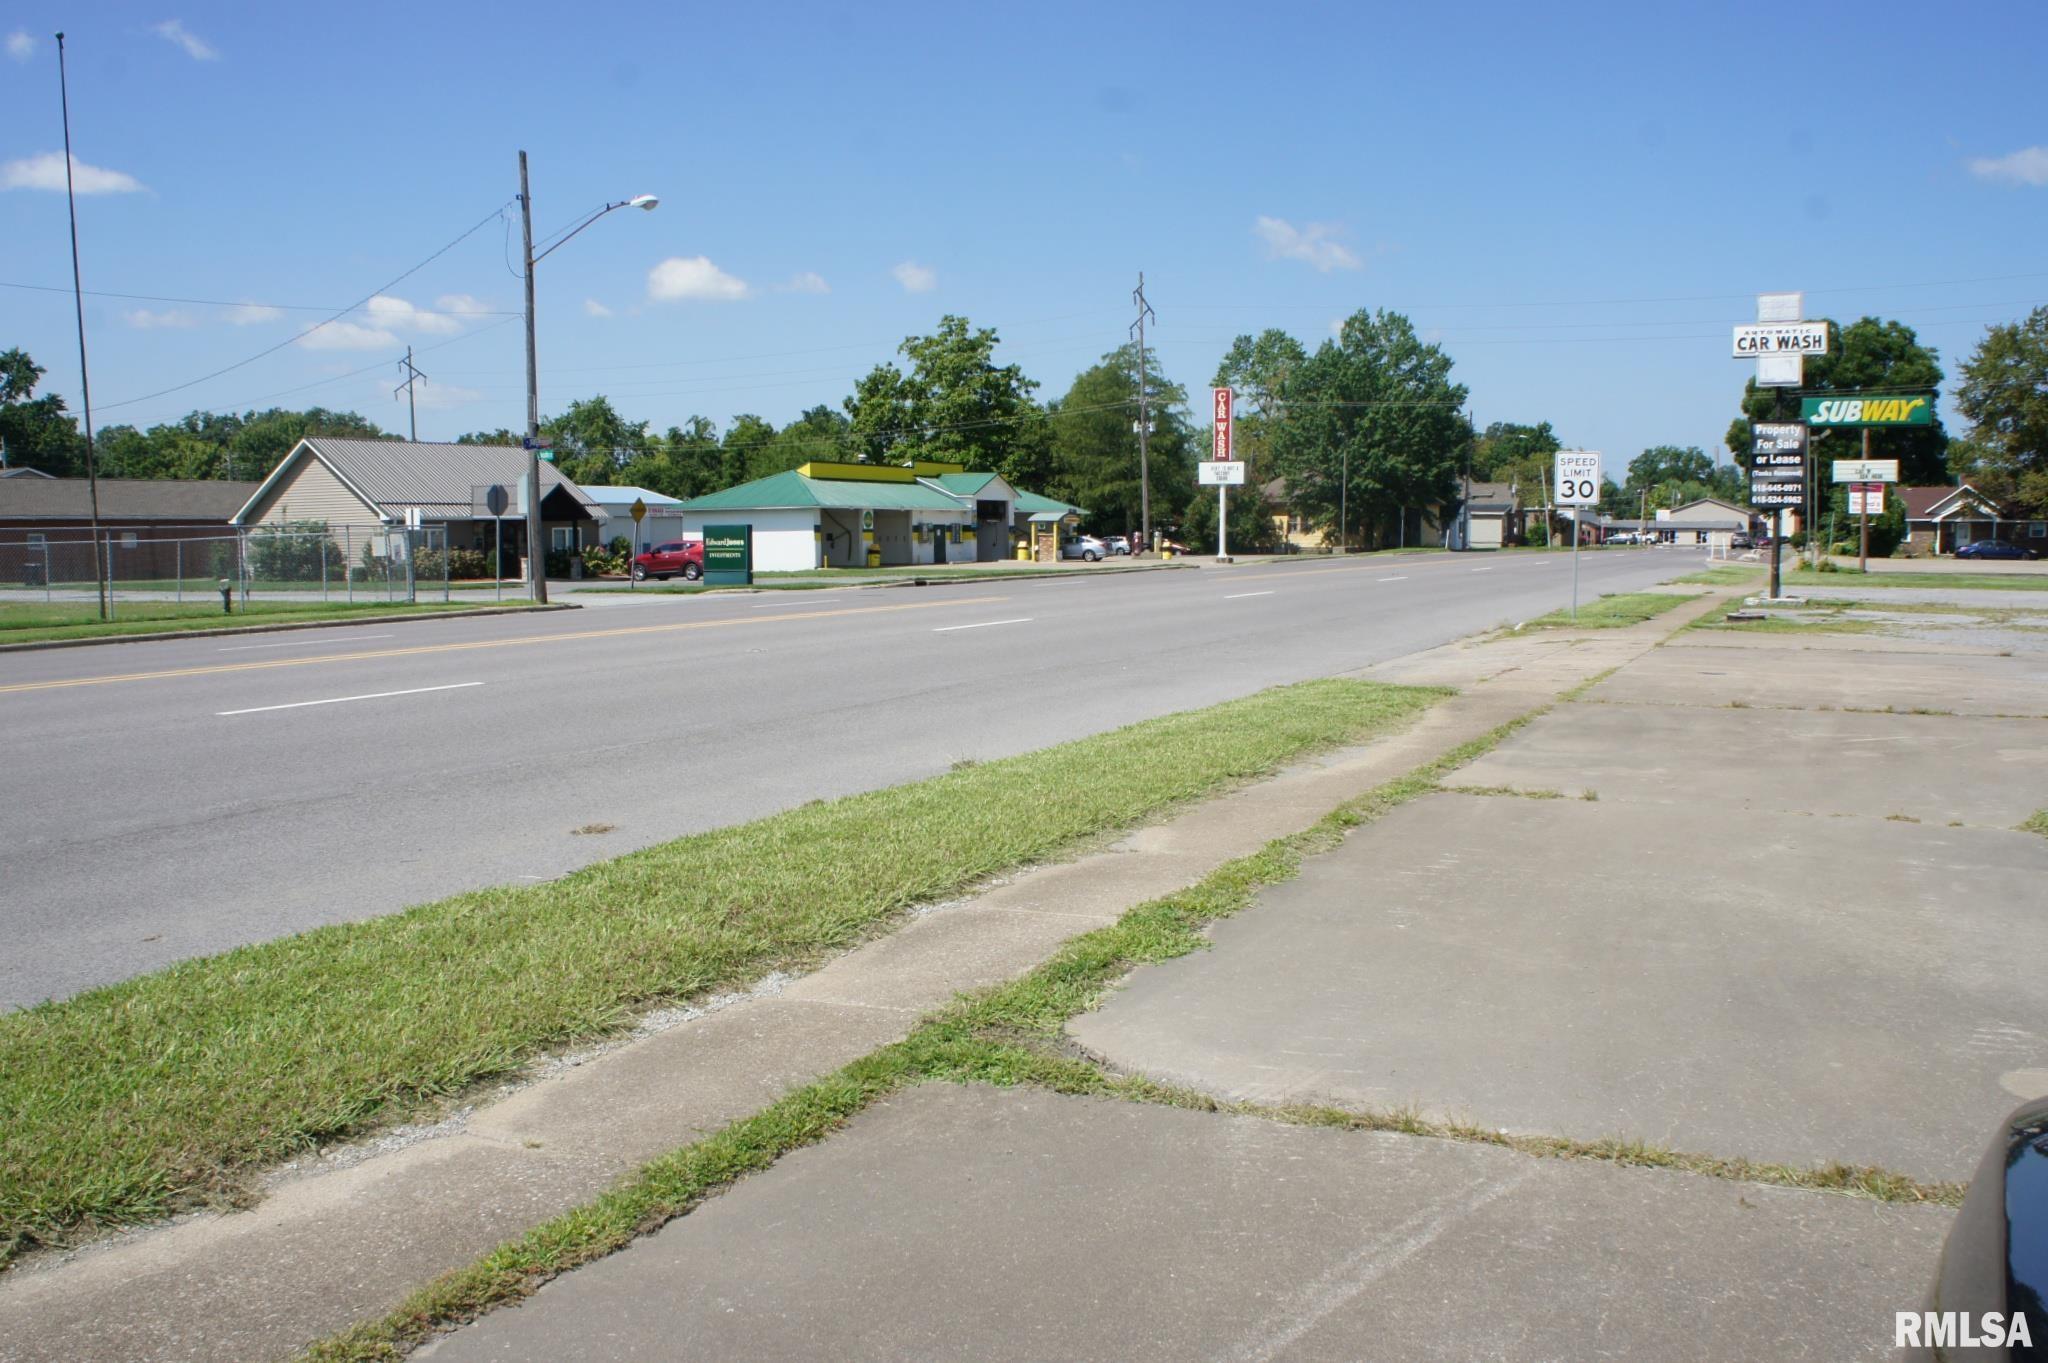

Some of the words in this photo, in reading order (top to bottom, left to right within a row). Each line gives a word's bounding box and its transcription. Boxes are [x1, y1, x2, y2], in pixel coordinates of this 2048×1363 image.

[1737, 336, 1769, 350] CAR
[1777, 335, 1822, 349] WASH
[1217, 392, 1226, 419] CAR
[1810, 398, 1925, 423] SUBWAY
[1755, 424, 1801, 437] Property
[1216, 422, 1227, 457] WASH
[1756, 438, 1774, 449] For
[1776, 438, 1800, 449] Sale
[1560, 457, 1597, 466] SPEED
[1756, 455, 1768, 464] or
[1769, 454, 1801, 464] Lease
[1563, 469, 1591, 478] LIMIT
[1561, 480, 1594, 498] 30
